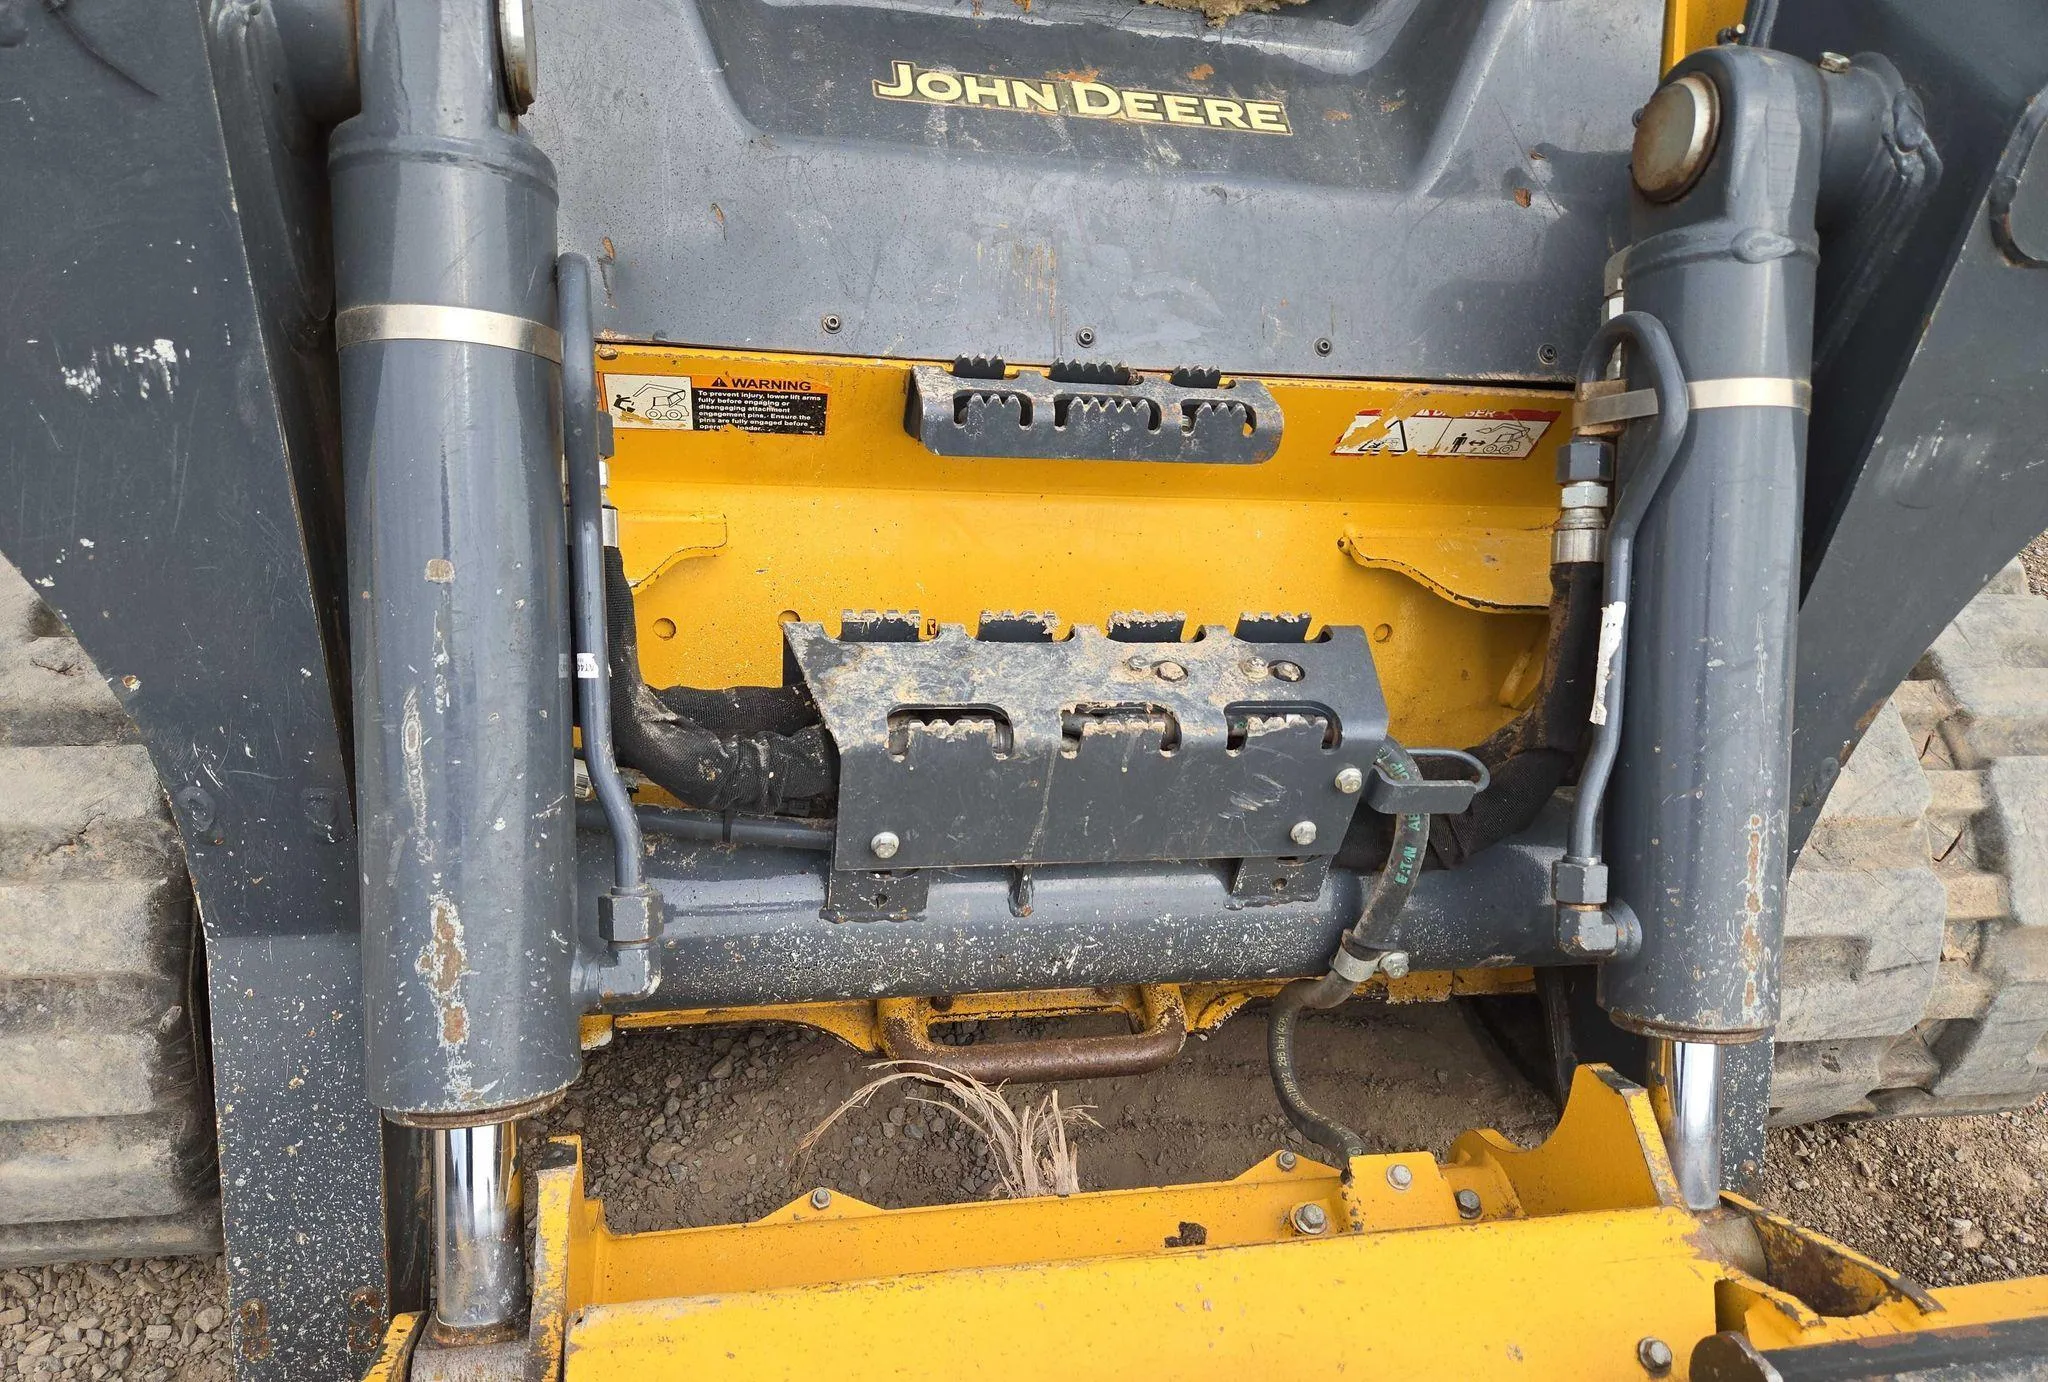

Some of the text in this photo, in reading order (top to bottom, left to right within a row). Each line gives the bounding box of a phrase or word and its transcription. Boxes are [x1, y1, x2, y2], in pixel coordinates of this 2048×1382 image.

[878, 63, 1289, 131] JOHN DEERE
[731, 378, 812, 391] WARNING
[741, 392, 765, 400] injury,
[698, 397, 716, 405] fully
[743, 399, 780, 407] engaging
[698, 403, 746, 412] disengaging
[698, 410, 746, 418] engagement
[1432, 408, 1497, 418] DGER
[731, 418, 749, 426] fully
[1276, 1036, 1286, 1050] bar
[1277, 1051, 1288, 1067] 295
